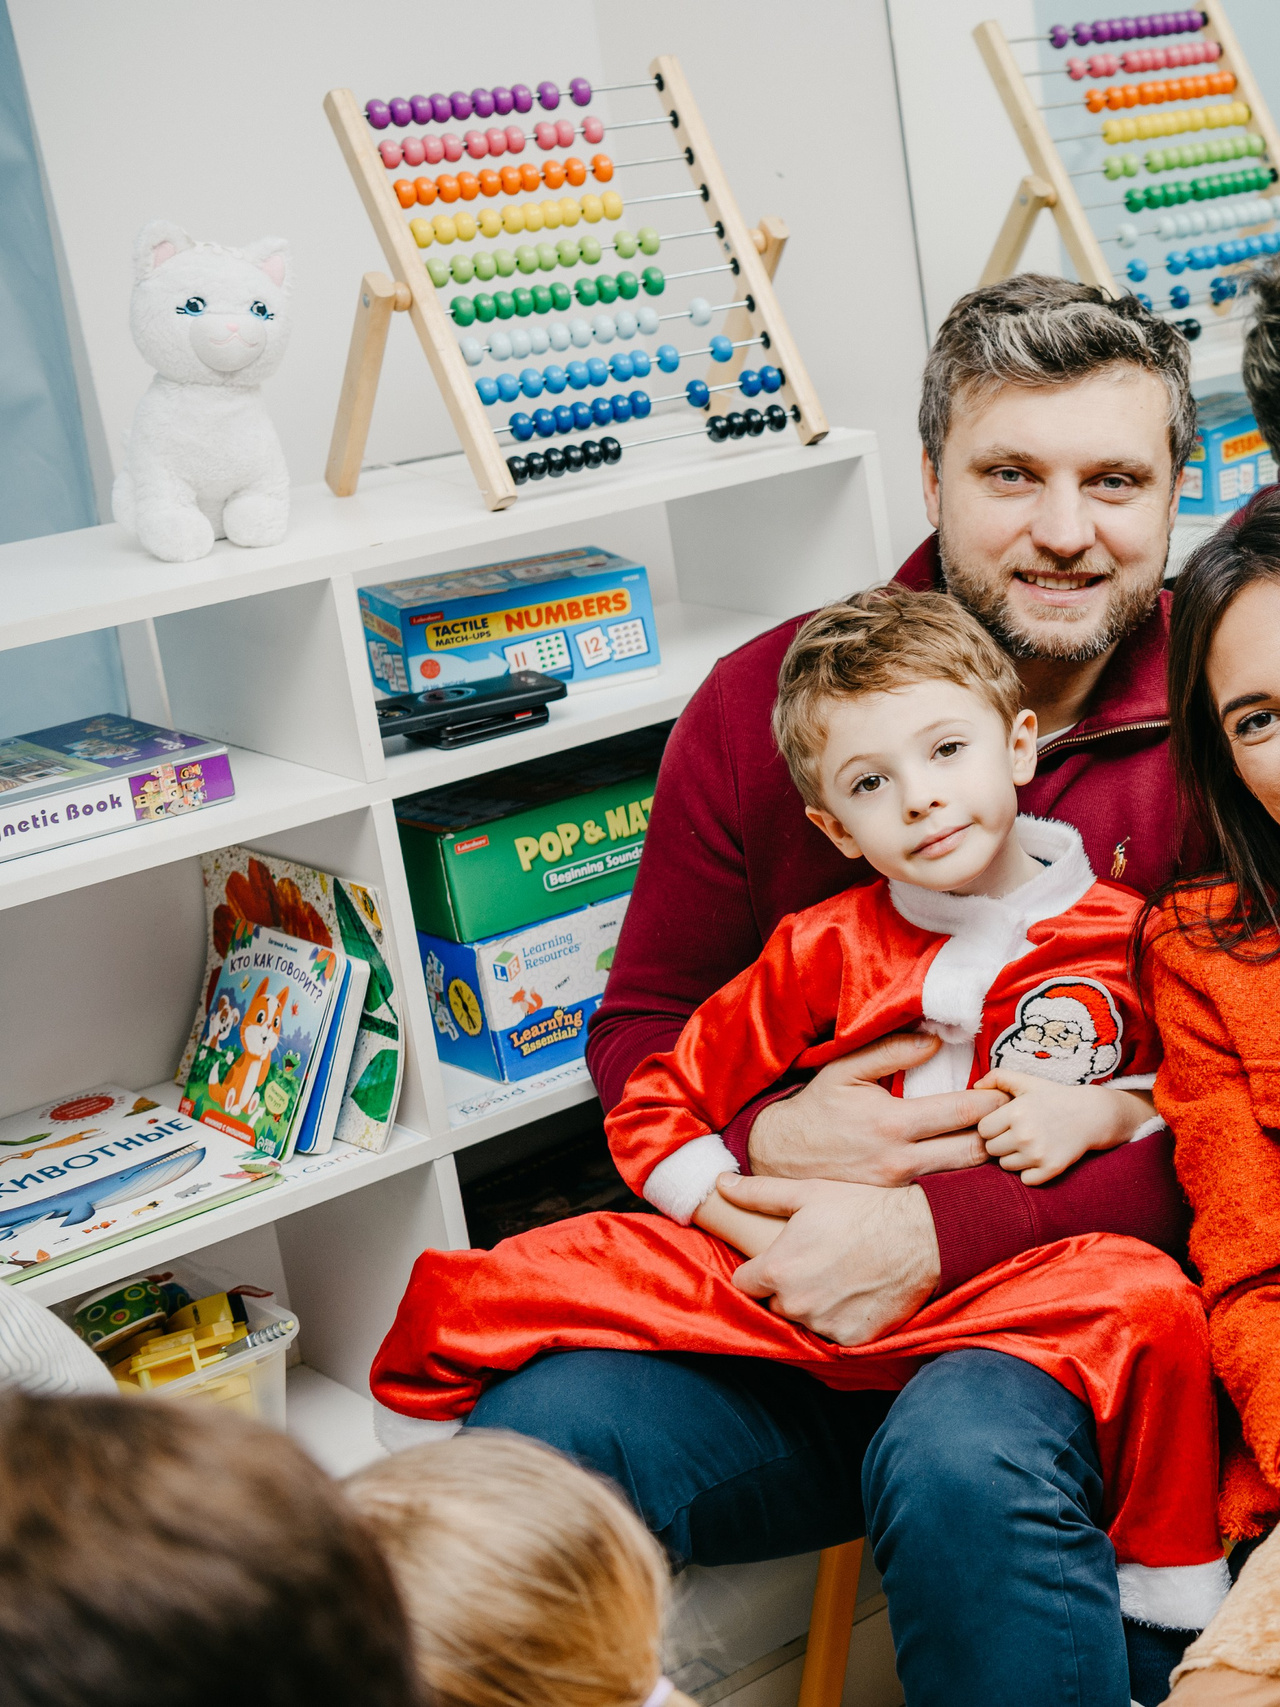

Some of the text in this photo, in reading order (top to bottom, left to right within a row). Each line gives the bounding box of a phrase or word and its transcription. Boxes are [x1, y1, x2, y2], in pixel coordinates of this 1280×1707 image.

[505, 592, 627, 633] NUMBERS
[433, 617, 489, 637] TACTILE
[435, 630, 492, 647] MATCH-UPS
[584, 636, 602, 655] 12
[514, 651, 527, 668] 11
[0, 793, 123, 842] netic Book
[514, 822, 581, 872] POP
[582, 820, 607, 845] &
[549, 860, 604, 887] Beginning
[522, 933, 573, 958] Learning
[524, 943, 580, 970] Resources
[230, 952, 323, 1004] КТО КАК ГОВОРИТ?
[510, 1008, 583, 1048] Learning
[520, 1026, 578, 1056] Essentials
